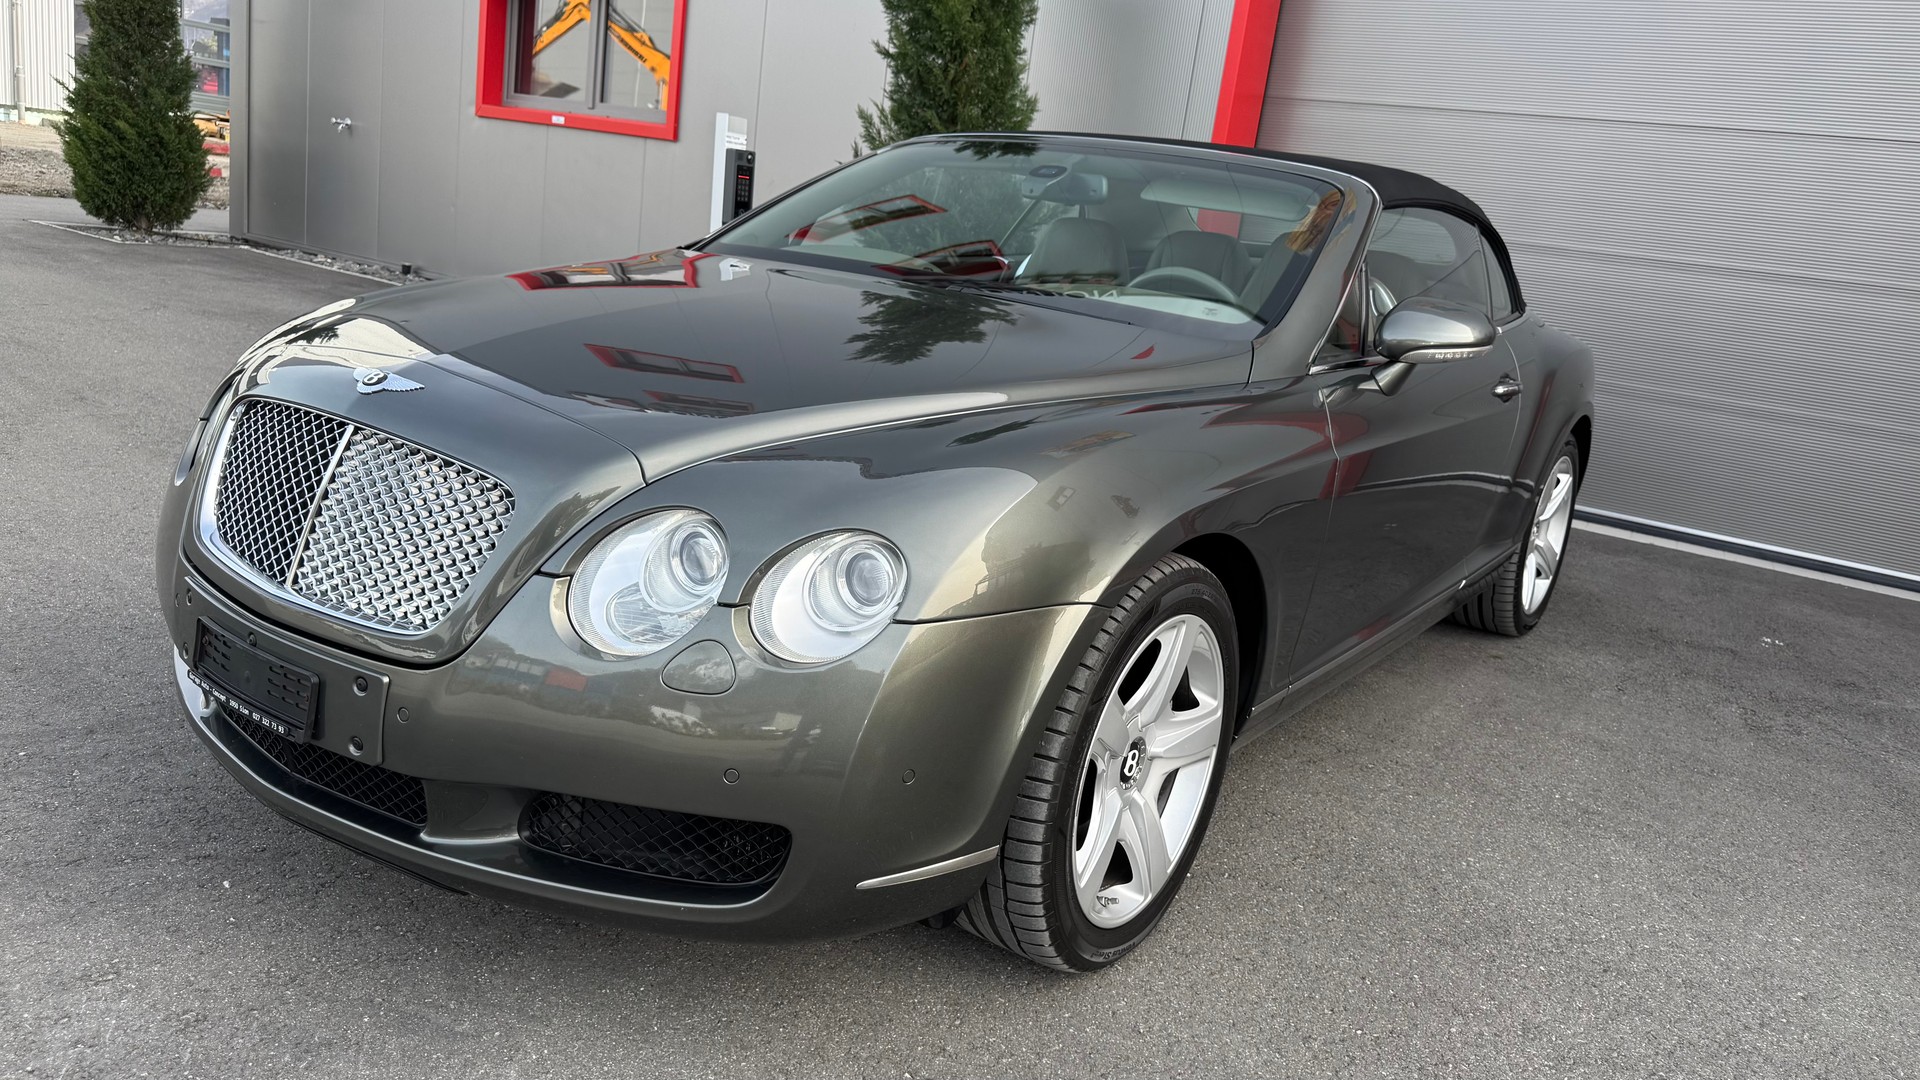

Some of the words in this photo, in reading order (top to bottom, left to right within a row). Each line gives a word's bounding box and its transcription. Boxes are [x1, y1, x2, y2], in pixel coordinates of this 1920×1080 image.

[201, 681, 210, 691] Auto
[212, 688, 227, 703] Concept
[229, 699, 239, 710] 1950
[239, 705, 249, 716] Sion
[252, 712, 260, 721] 027
[261, 717, 270, 727] 322
[271, 721, 277, 730] 73
[278, 725, 285, 734] 93
